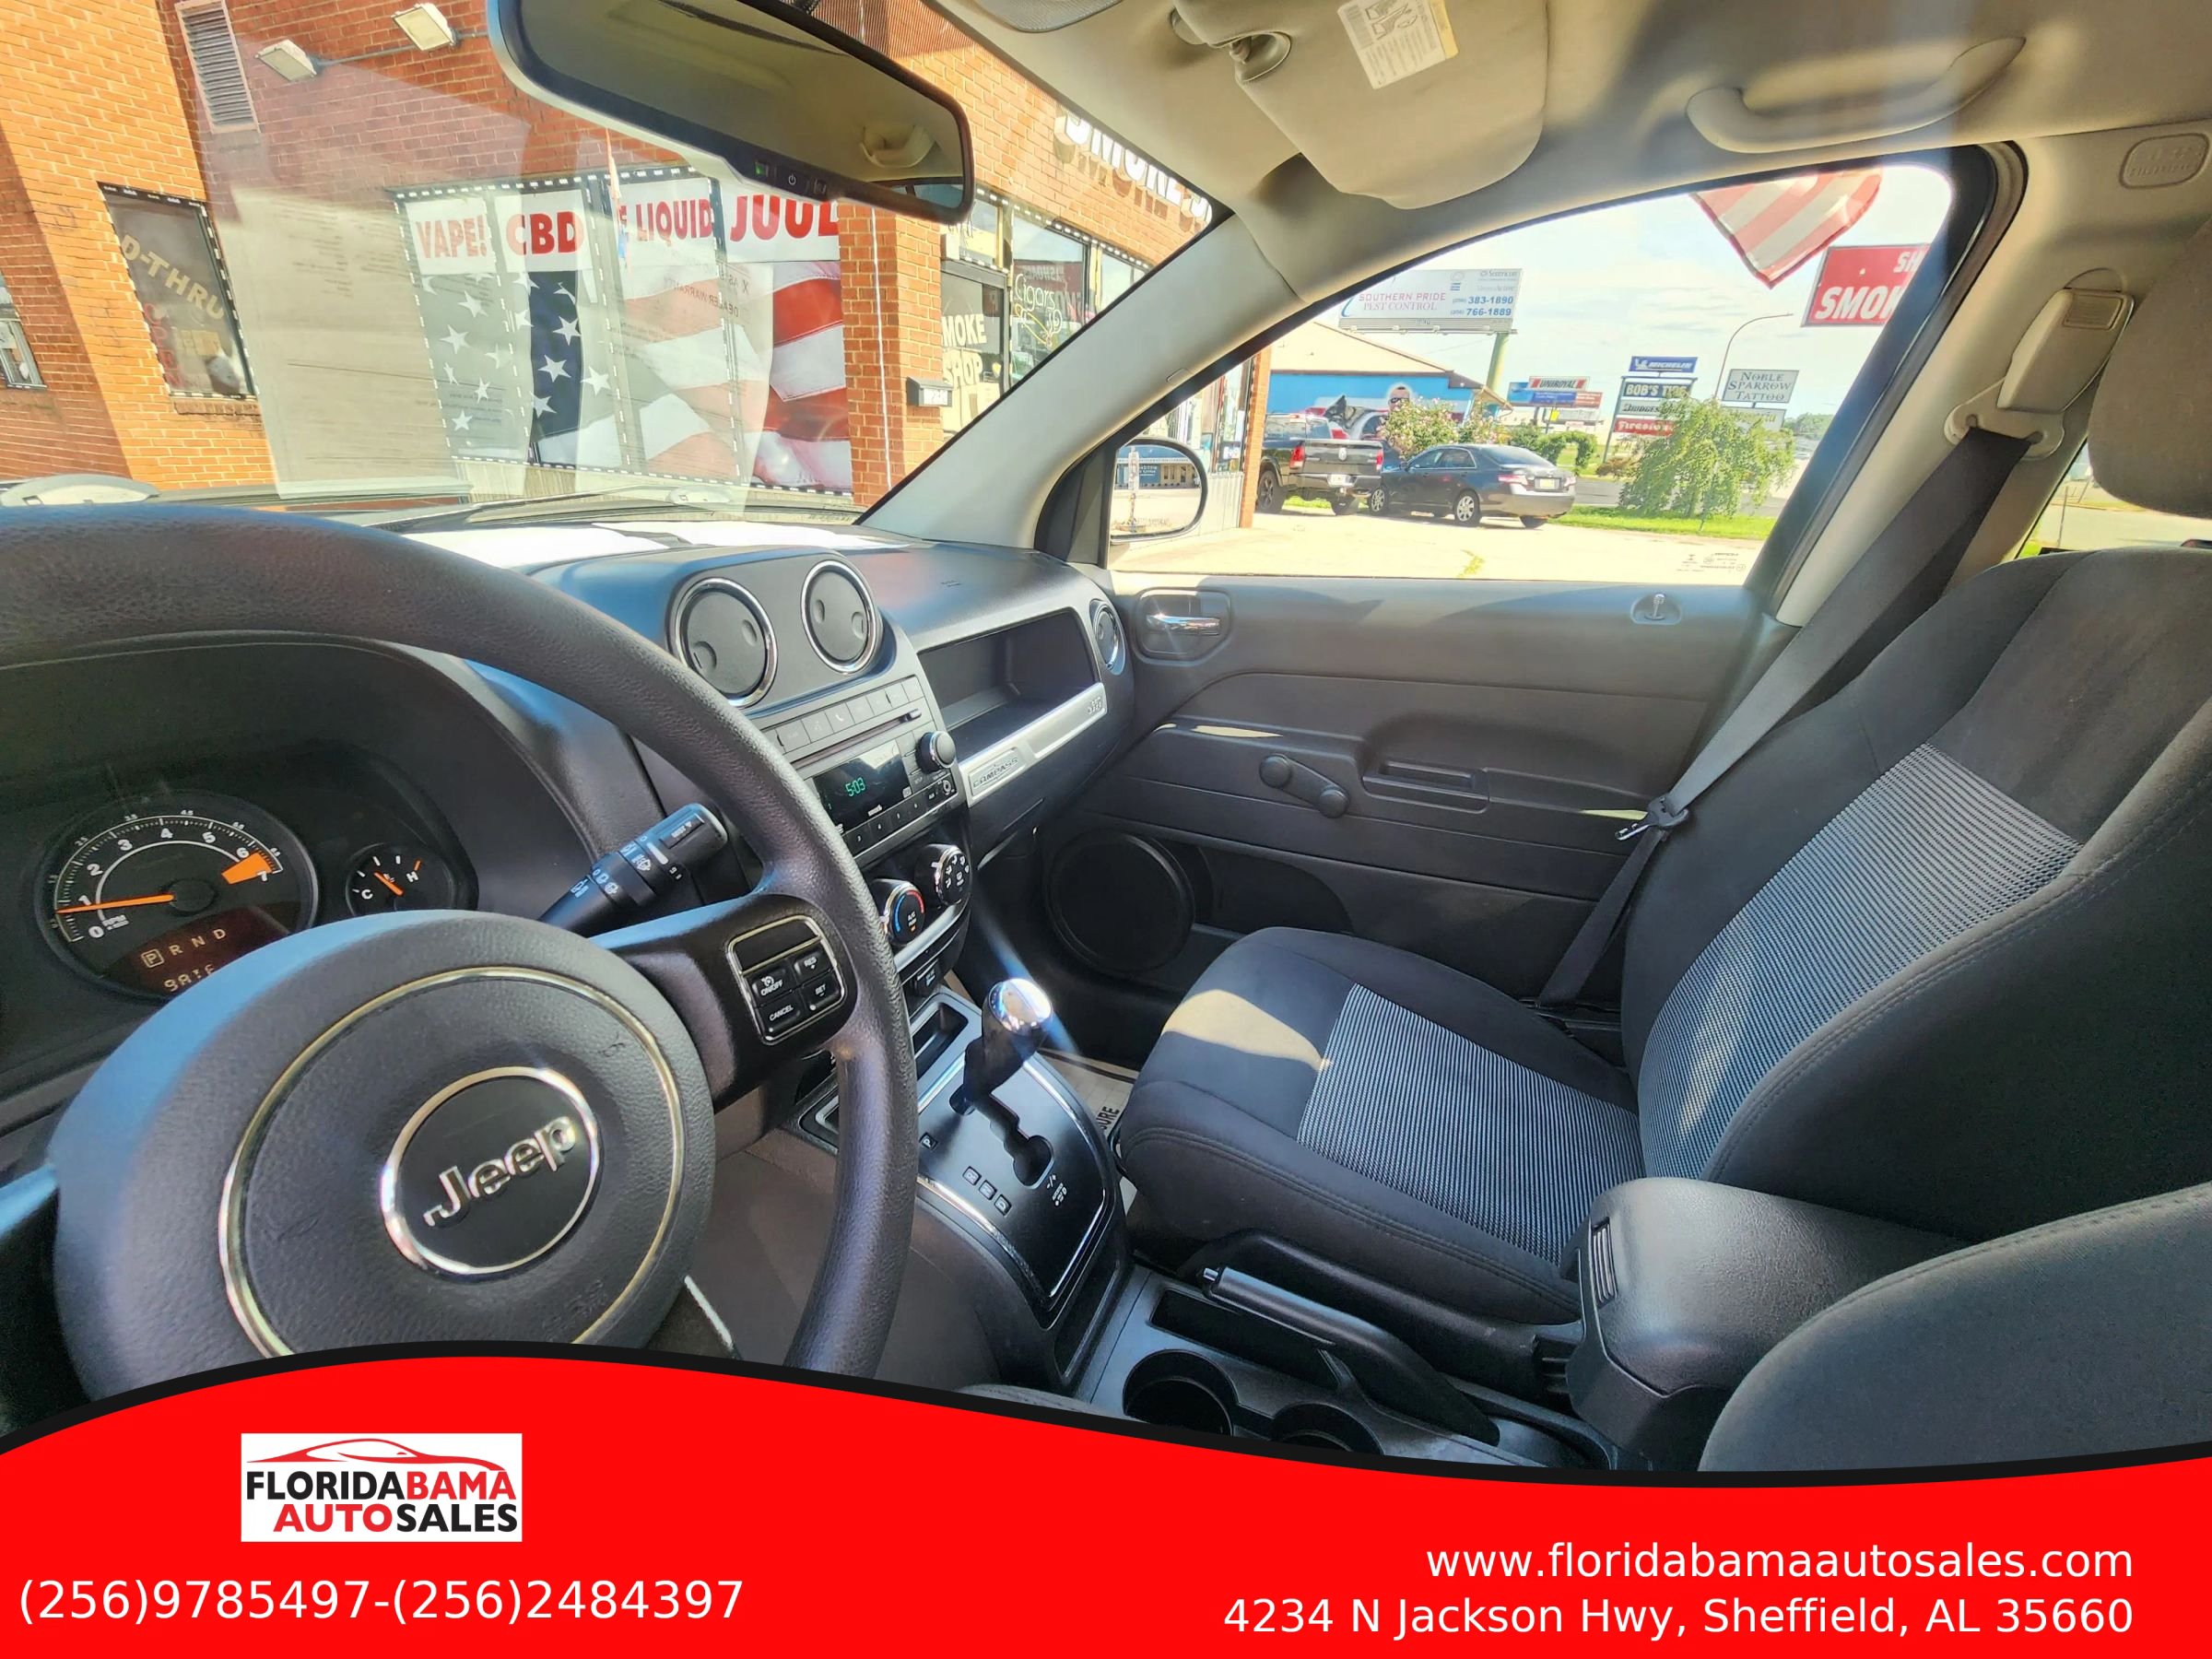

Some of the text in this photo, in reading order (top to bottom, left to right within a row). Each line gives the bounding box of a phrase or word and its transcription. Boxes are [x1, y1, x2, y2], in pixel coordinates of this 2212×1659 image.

[416, 215, 487, 258] VAPE!
[507, 211, 584, 255] CBD
[636, 199, 712, 246] LIQUID
[730, 194, 839, 241] JUUL
[1015, 273, 1056, 312] Cigars
[1359, 292, 1446, 302] SOUTHERN PRIDE
[1468, 296, 1514, 305] 383-1890
[1363, 302, 1439, 312] PEST CONTROL
[1466, 308, 1512, 317] 766-1889
[1647, 360, 1693, 369] MICHELIN
[1740, 372, 1784, 382] NOBLE
[1539, 379, 1577, 389] UNIROYAL
[1626, 383, 1658, 395] BOB'S
[1727, 381, 1793, 391] SPARROW
[1735, 391, 1784, 401] TATTOO
[973, 757, 1018, 788] COMPASS
[845, 777, 865, 797] 5:03
[159, 828, 173, 840] 4
[202, 831, 217, 843] 5
[117, 839, 133, 852] 3
[236, 847, 250, 859] 6
[87, 864, 103, 877] 2
[256, 870, 268, 882] 7
[406, 871, 418, 882] H
[361, 888, 373, 900] C
[88, 925, 104, 938] 0
[169, 945, 183, 956] R
[192, 935, 205, 947] N
[213, 929, 227, 941] D
[769, 1005, 794, 1021] CANCEL
[422, 1114, 578, 1228] Jeep
